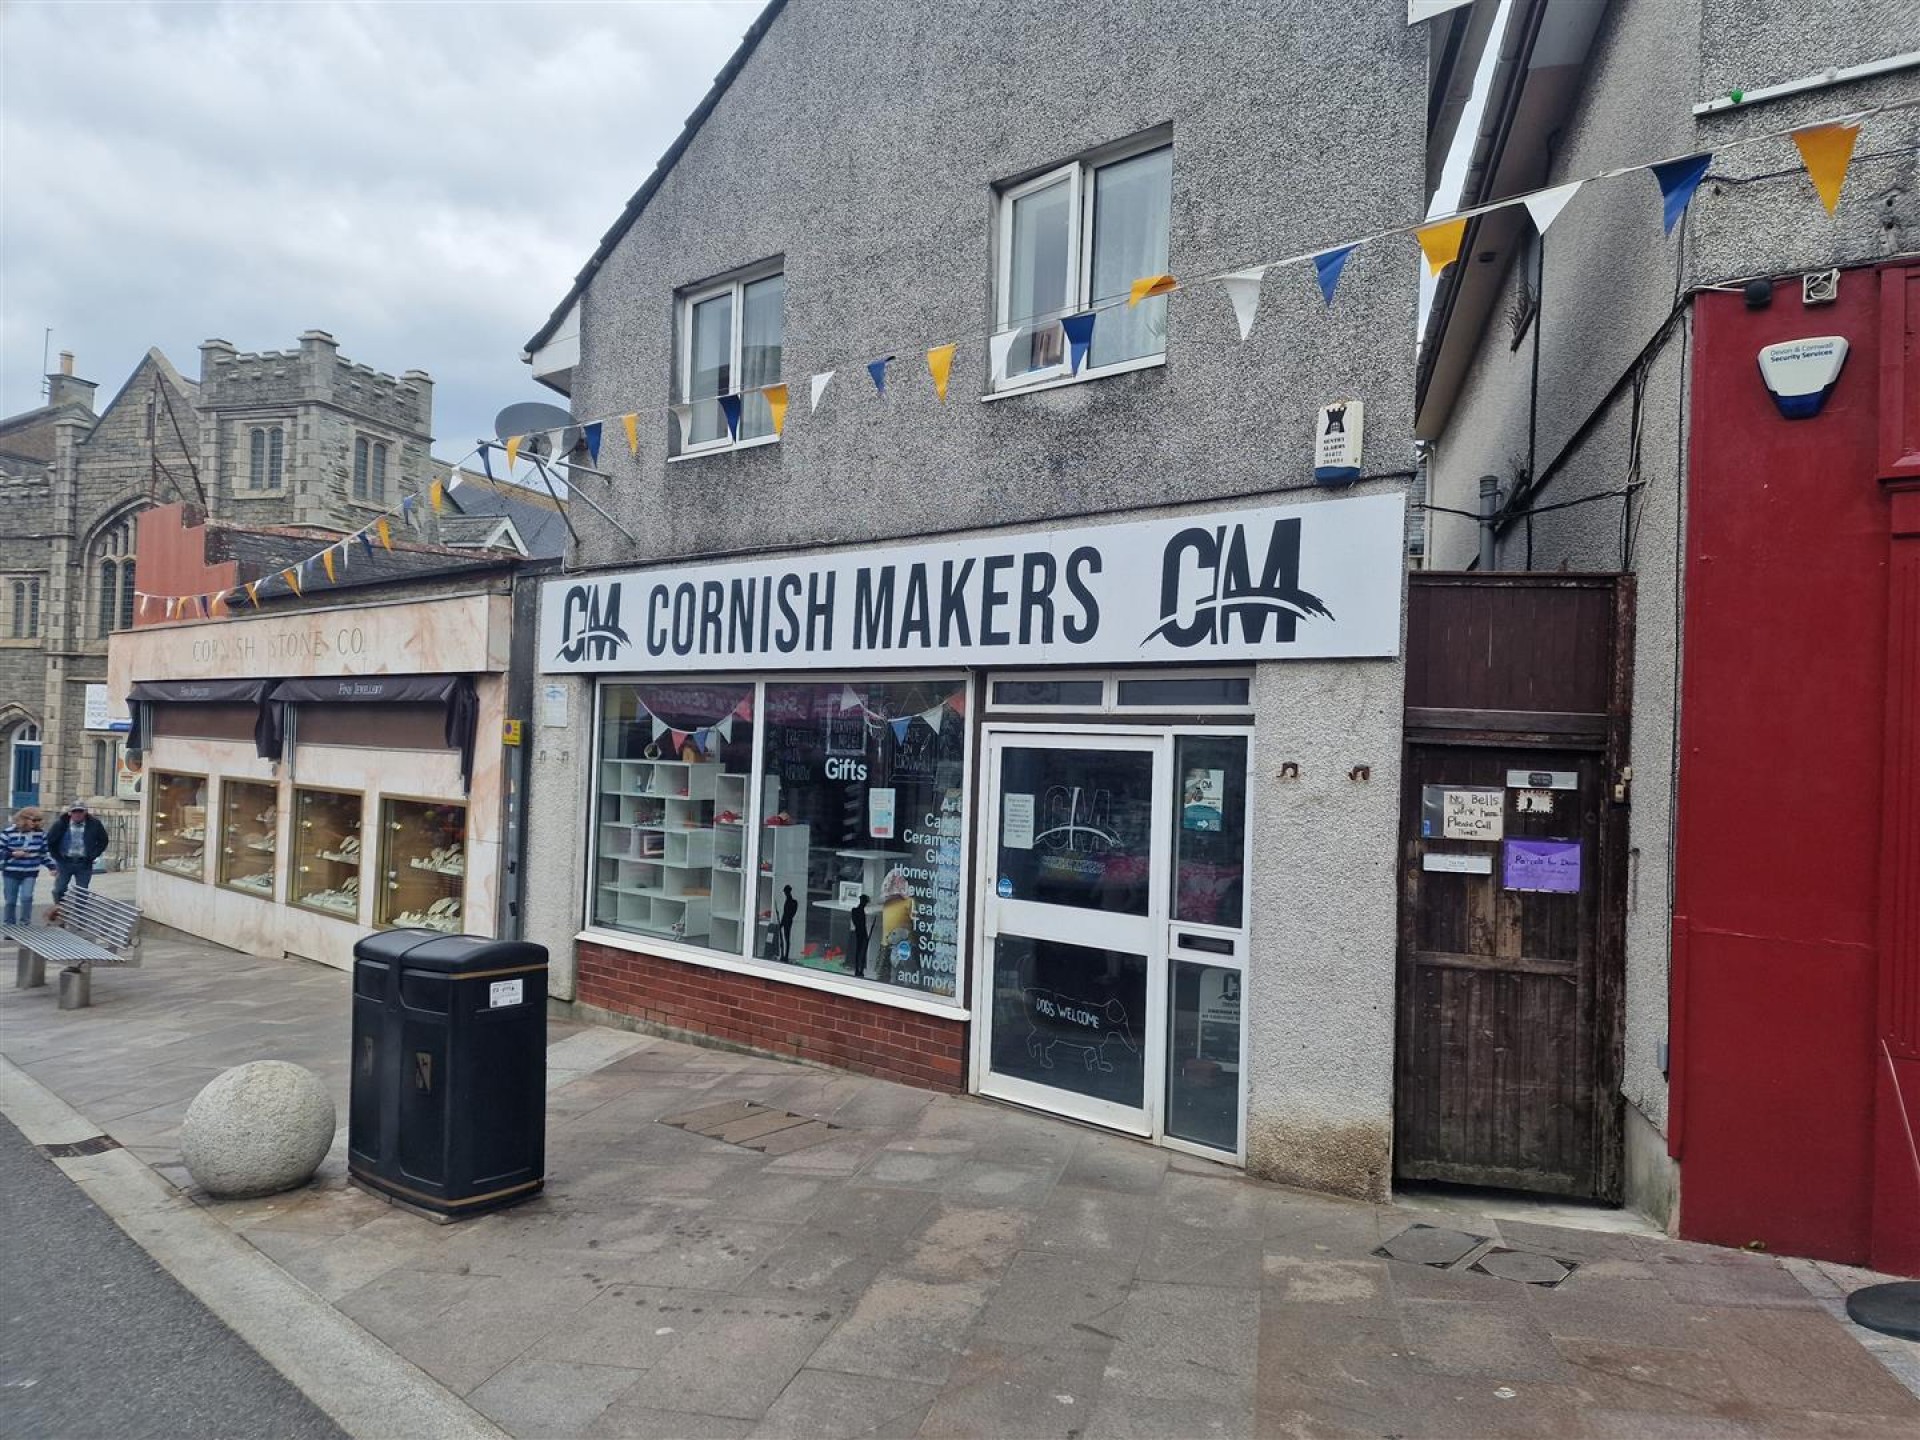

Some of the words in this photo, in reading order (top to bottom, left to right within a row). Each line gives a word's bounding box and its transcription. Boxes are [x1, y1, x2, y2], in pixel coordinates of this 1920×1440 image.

[1770, 353, 1801, 364] Security
[1802, 349, 1833, 359] Services
[647, 571, 836, 656] CORNISH
[853, 546, 1102, 650] MAKERS
[192, 637, 256, 663] CORNSH
[824, 757, 868, 781] Gifts
[1471, 794, 1500, 806] Bells
[919, 953, 956, 973] Wood
[898, 970, 920, 985] and
[923, 974, 956, 991] more
[1036, 998, 1055, 1017] DOGS
[1056, 1003, 1100, 1029] WELCOME
